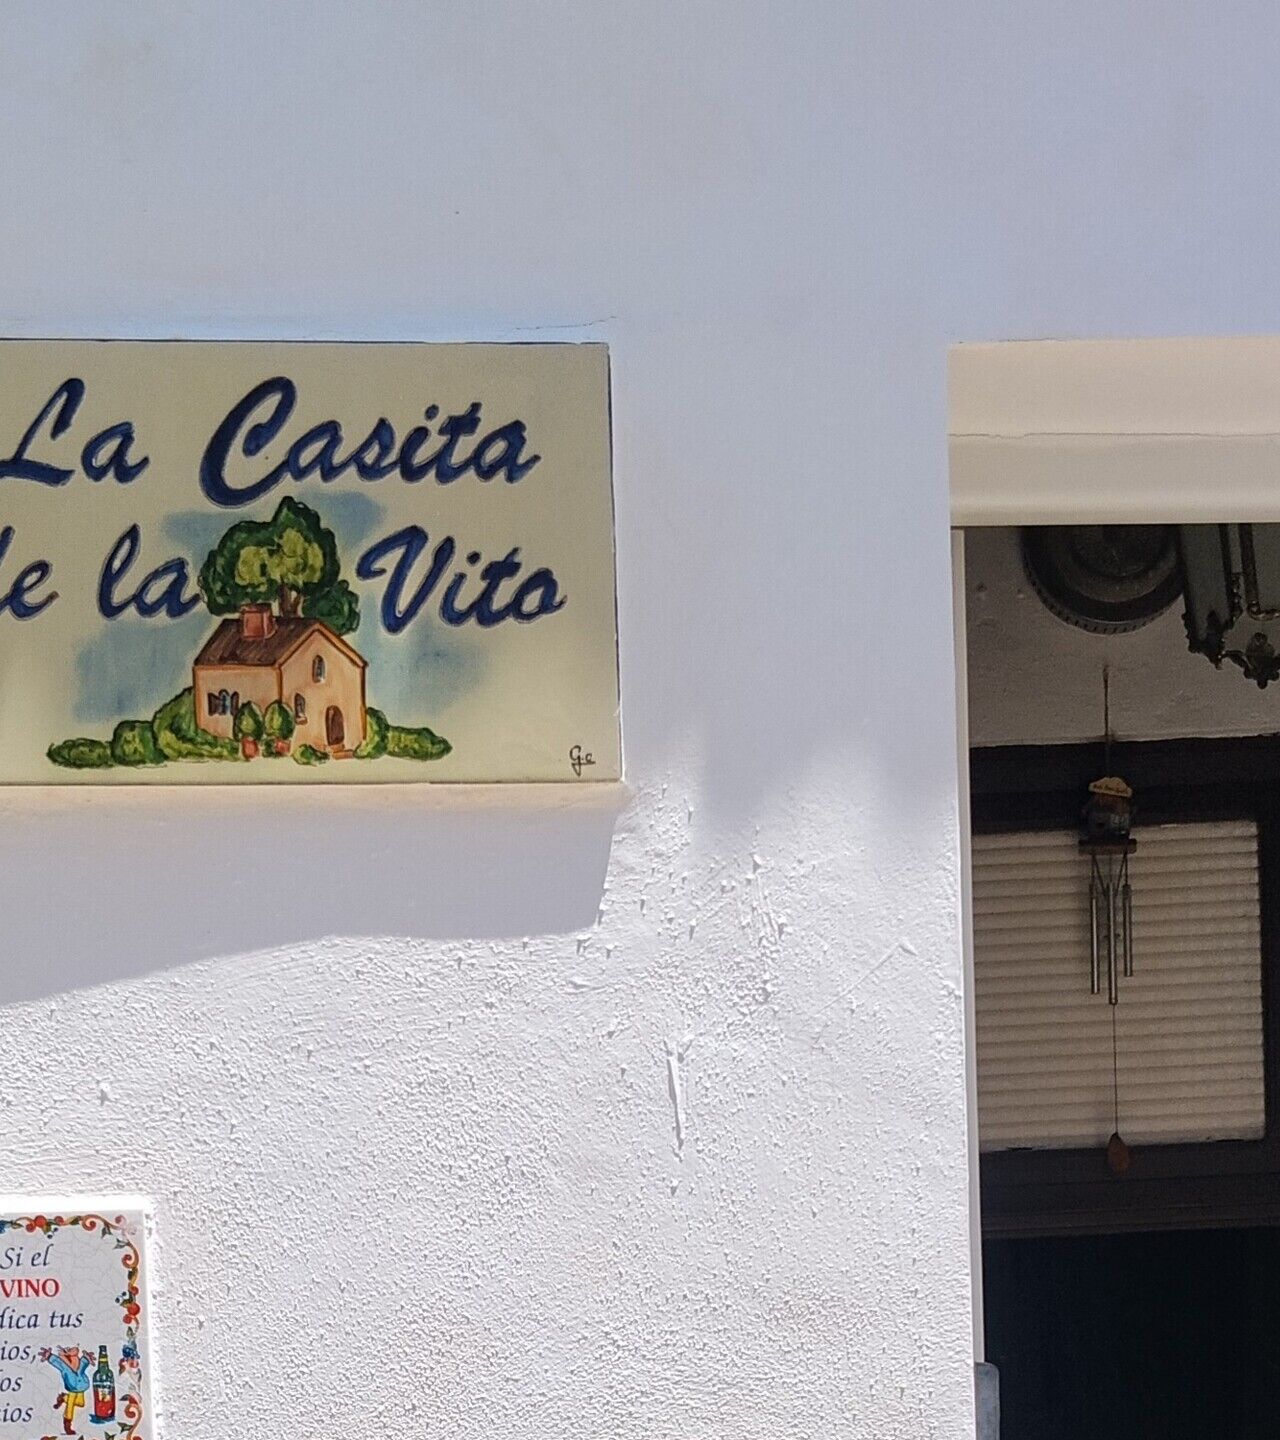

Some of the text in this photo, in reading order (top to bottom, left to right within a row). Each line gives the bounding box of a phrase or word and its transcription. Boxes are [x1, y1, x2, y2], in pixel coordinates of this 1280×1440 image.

[198, 375, 542, 508] Casita
[96, 523, 204, 620] la
[356, 525, 568, 635] Vito
[0, 1243, 55, 1270] Si el
[0, 1278, 61, 1298] VINO
[49, 1310, 84, 1328] tus
